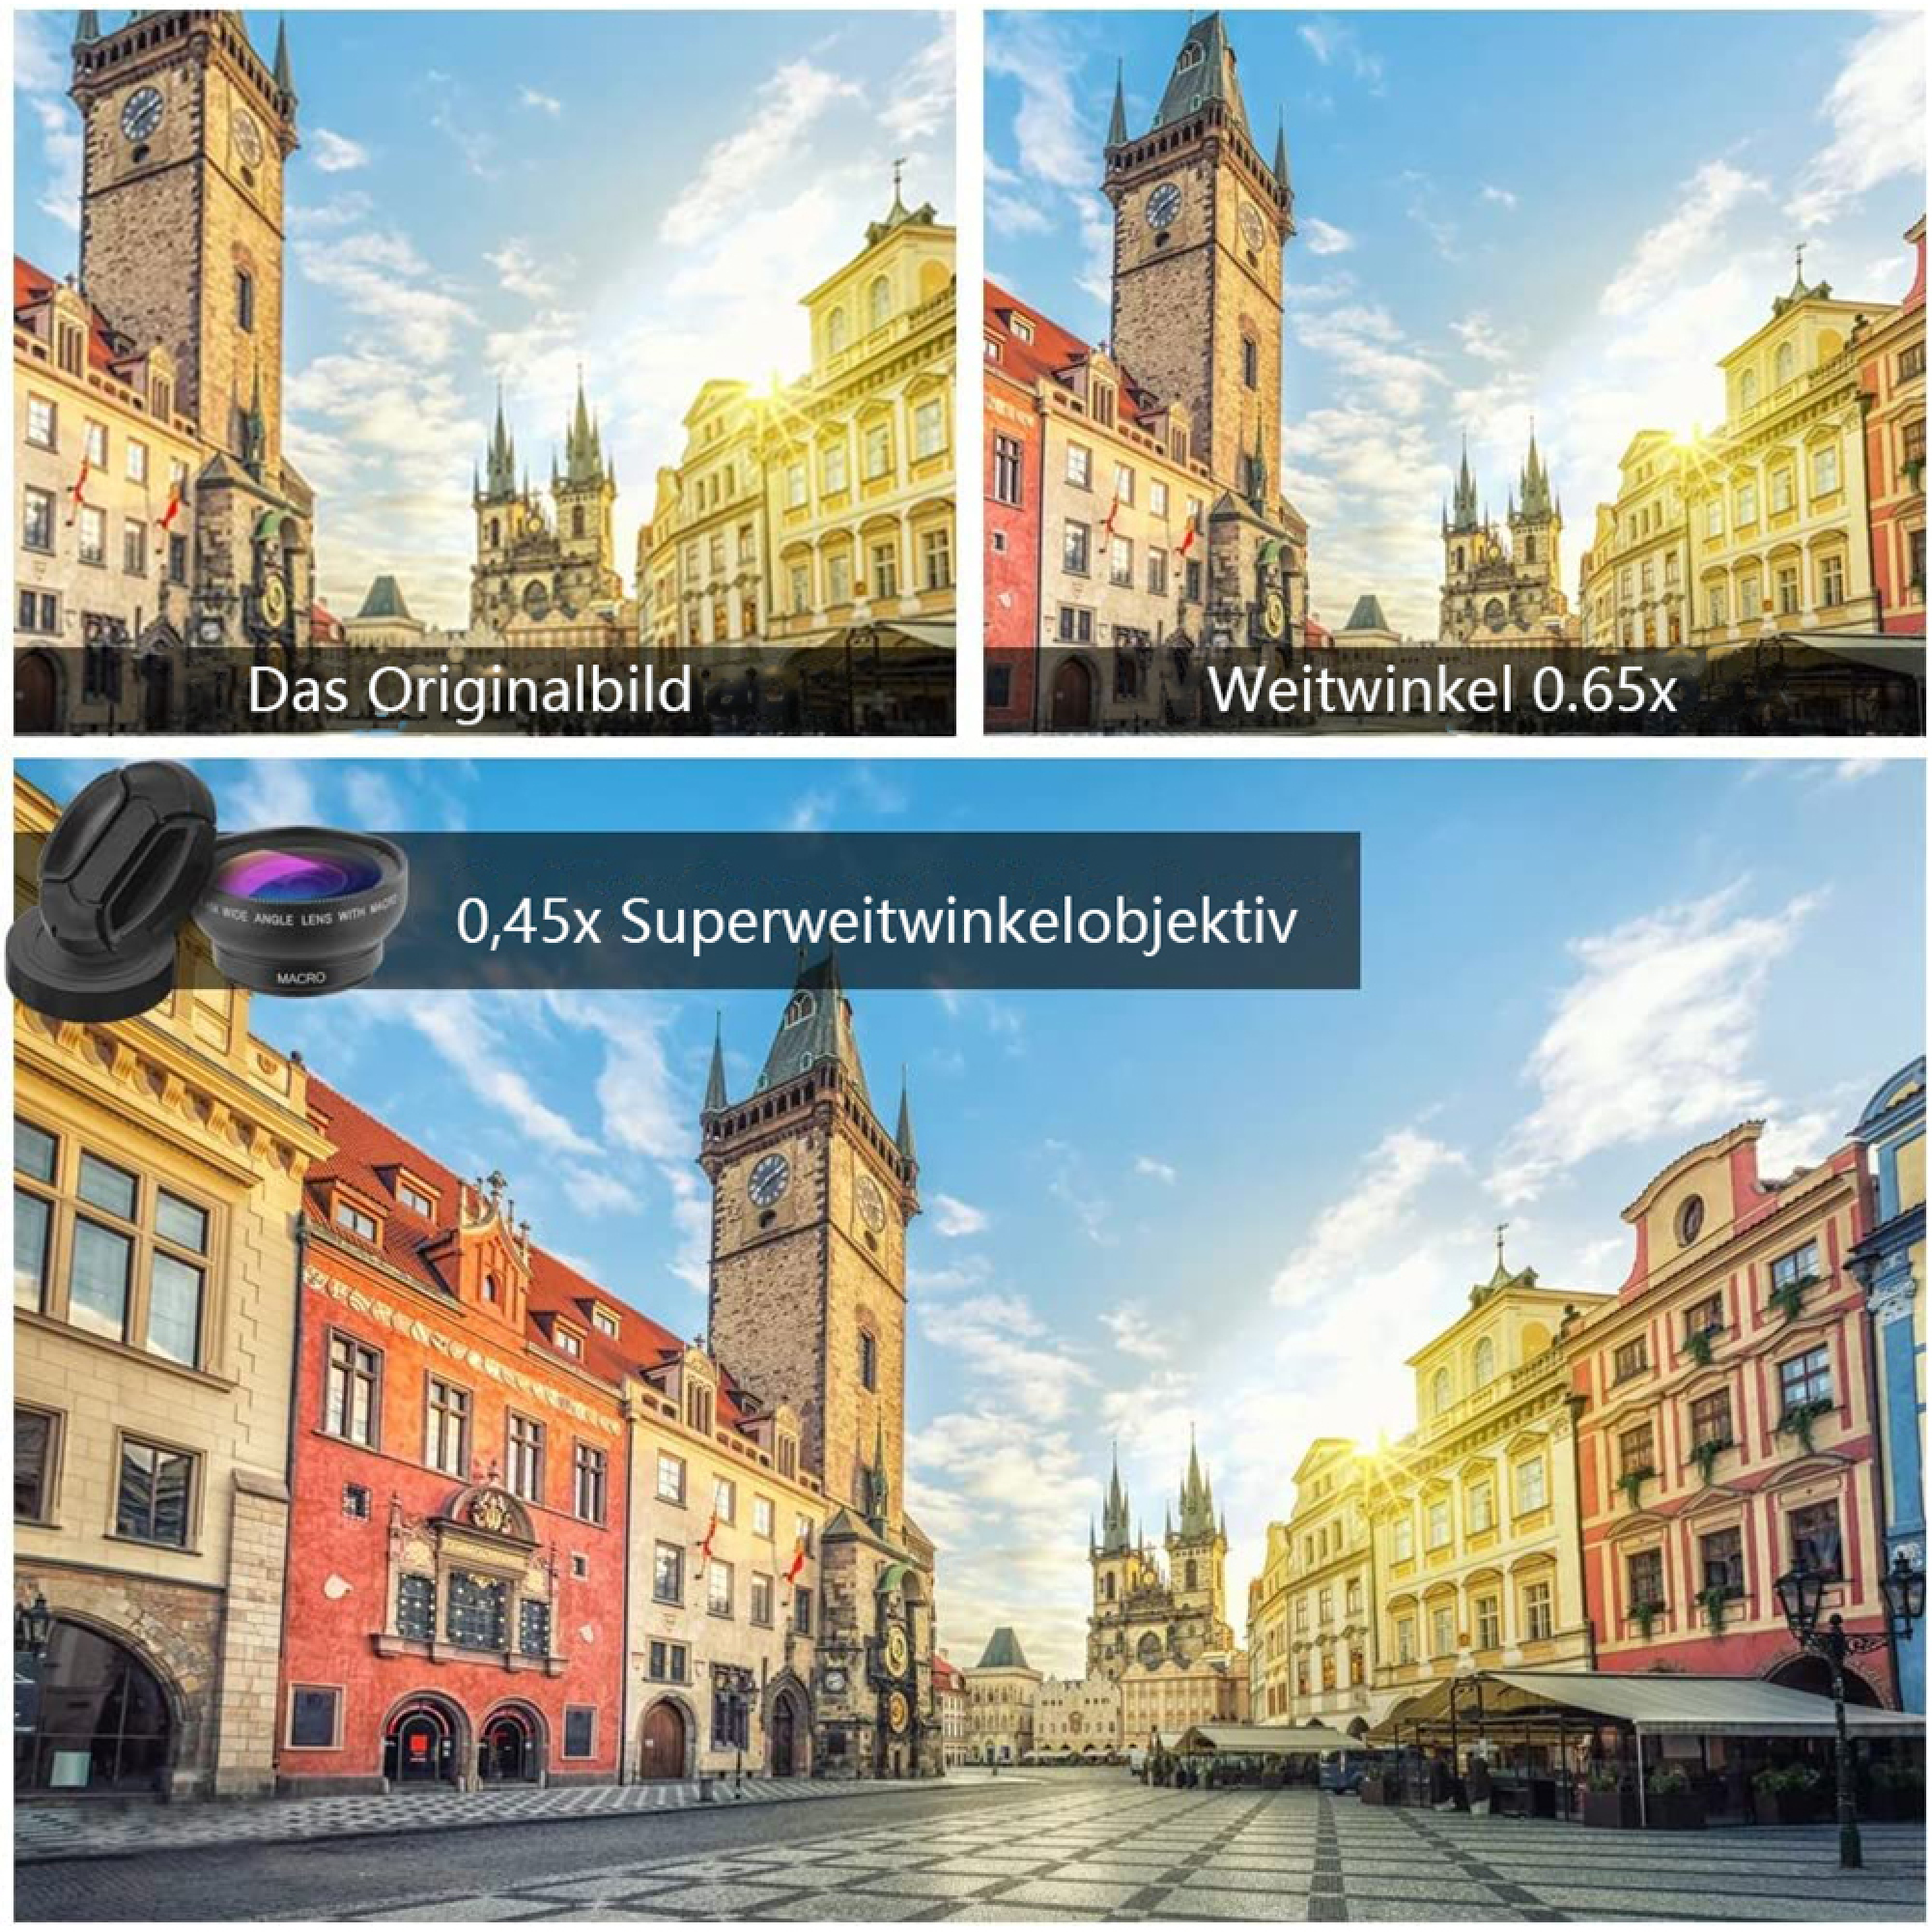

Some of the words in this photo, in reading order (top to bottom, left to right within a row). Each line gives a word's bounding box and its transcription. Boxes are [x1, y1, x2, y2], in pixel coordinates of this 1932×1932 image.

[222, 906, 248, 923] WIDE
[254, 913, 295, 926] ANGLE
[300, 913, 333, 926] LENS
[339, 906, 367, 922] WITH
[276, 971, 327, 984] MACRO
